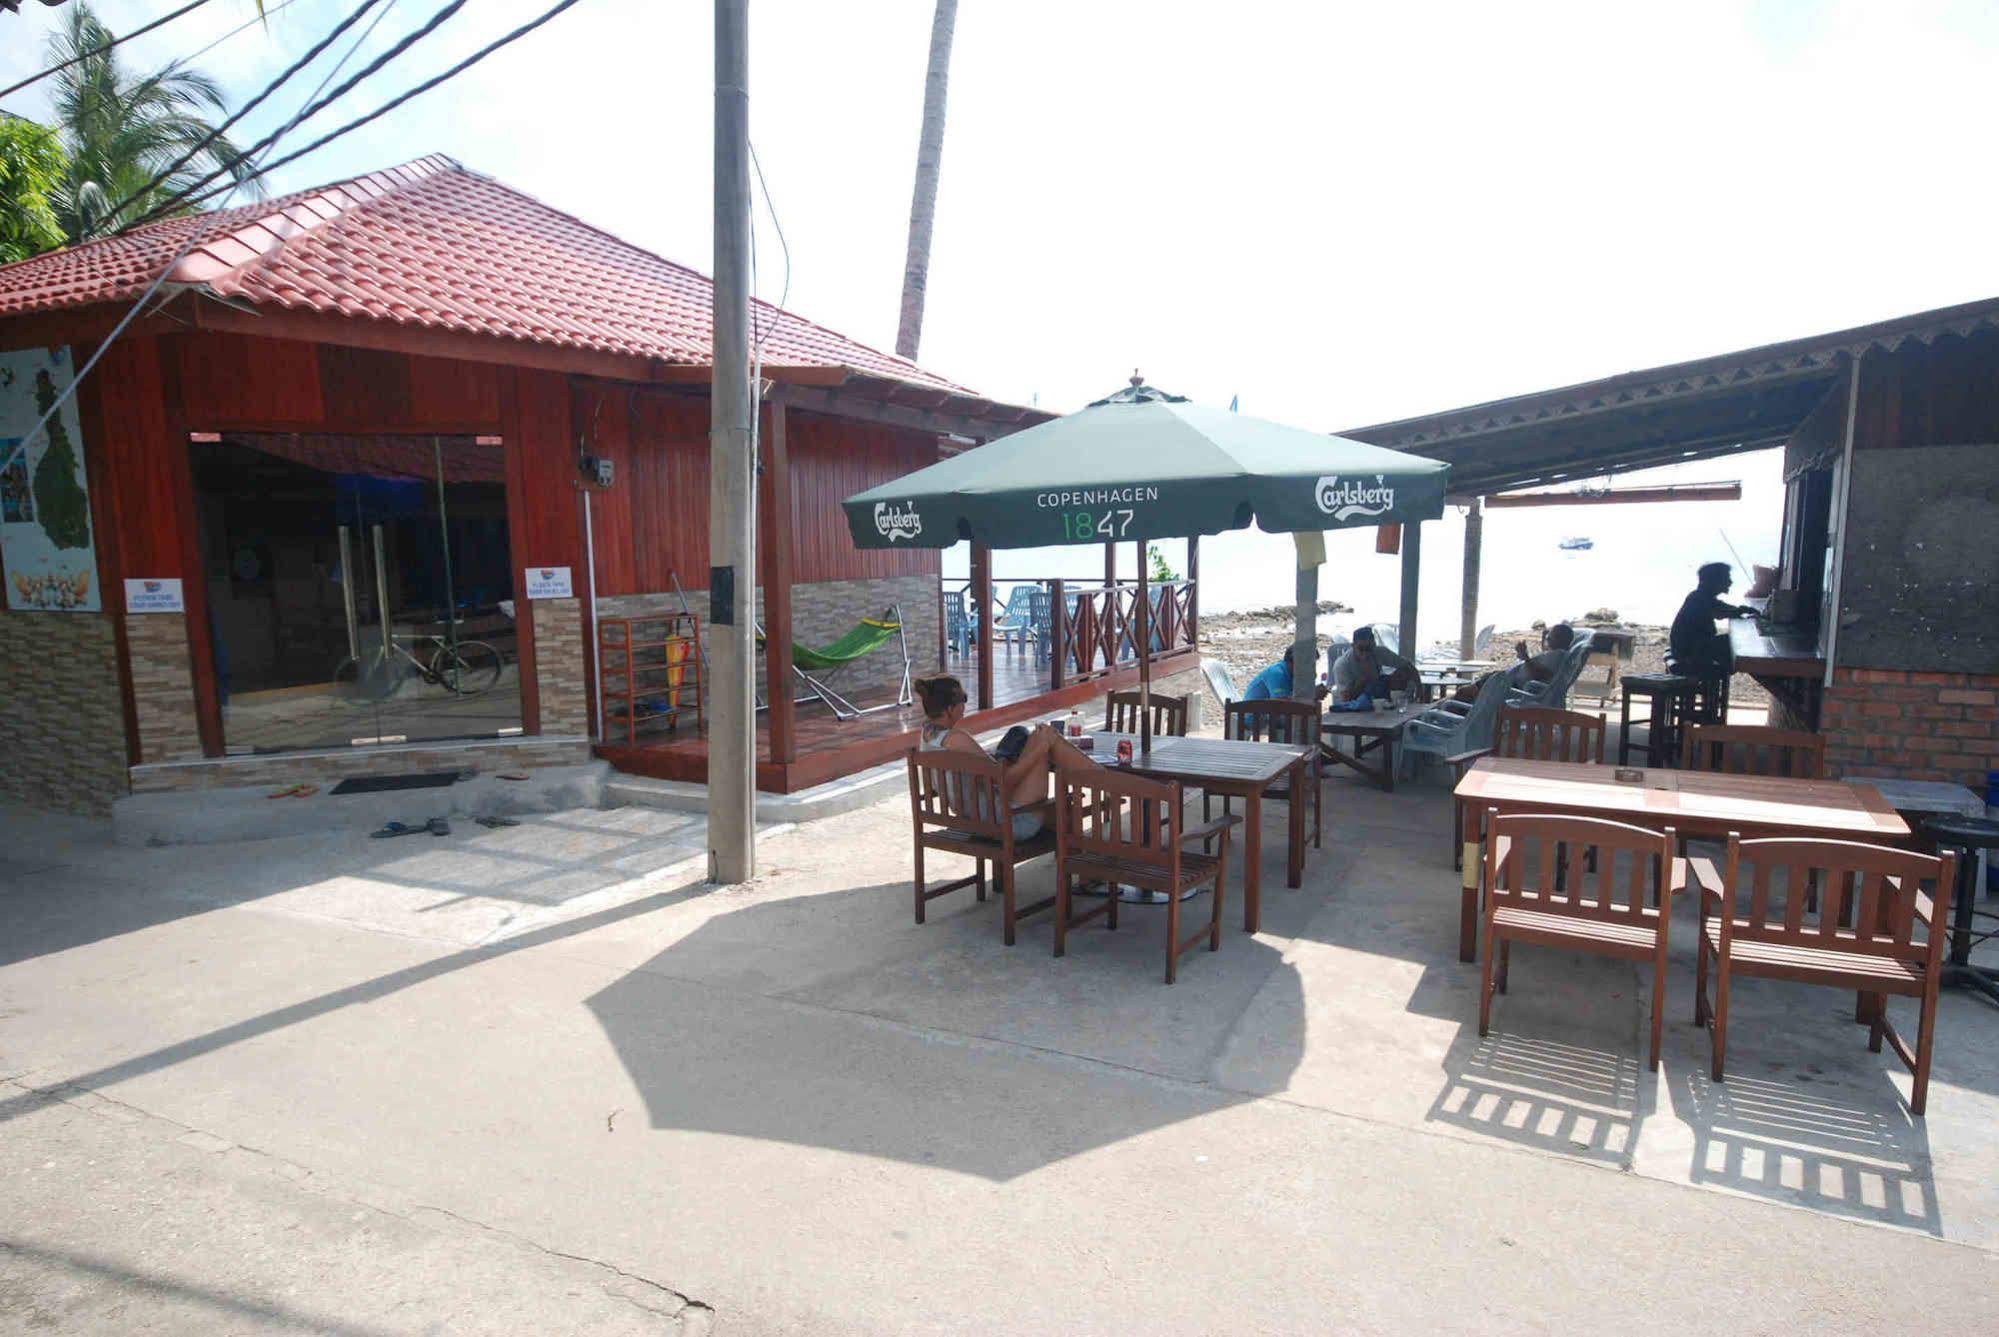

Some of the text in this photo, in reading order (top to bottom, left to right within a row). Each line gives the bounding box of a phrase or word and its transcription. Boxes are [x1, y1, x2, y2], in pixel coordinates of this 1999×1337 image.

[1037, 487, 1158, 507] COPENHAGEN
[1315, 475, 1394, 521] Carlsberg
[874, 501, 922, 541] Carlsberg
[1063, 509, 1134, 539] 1847
